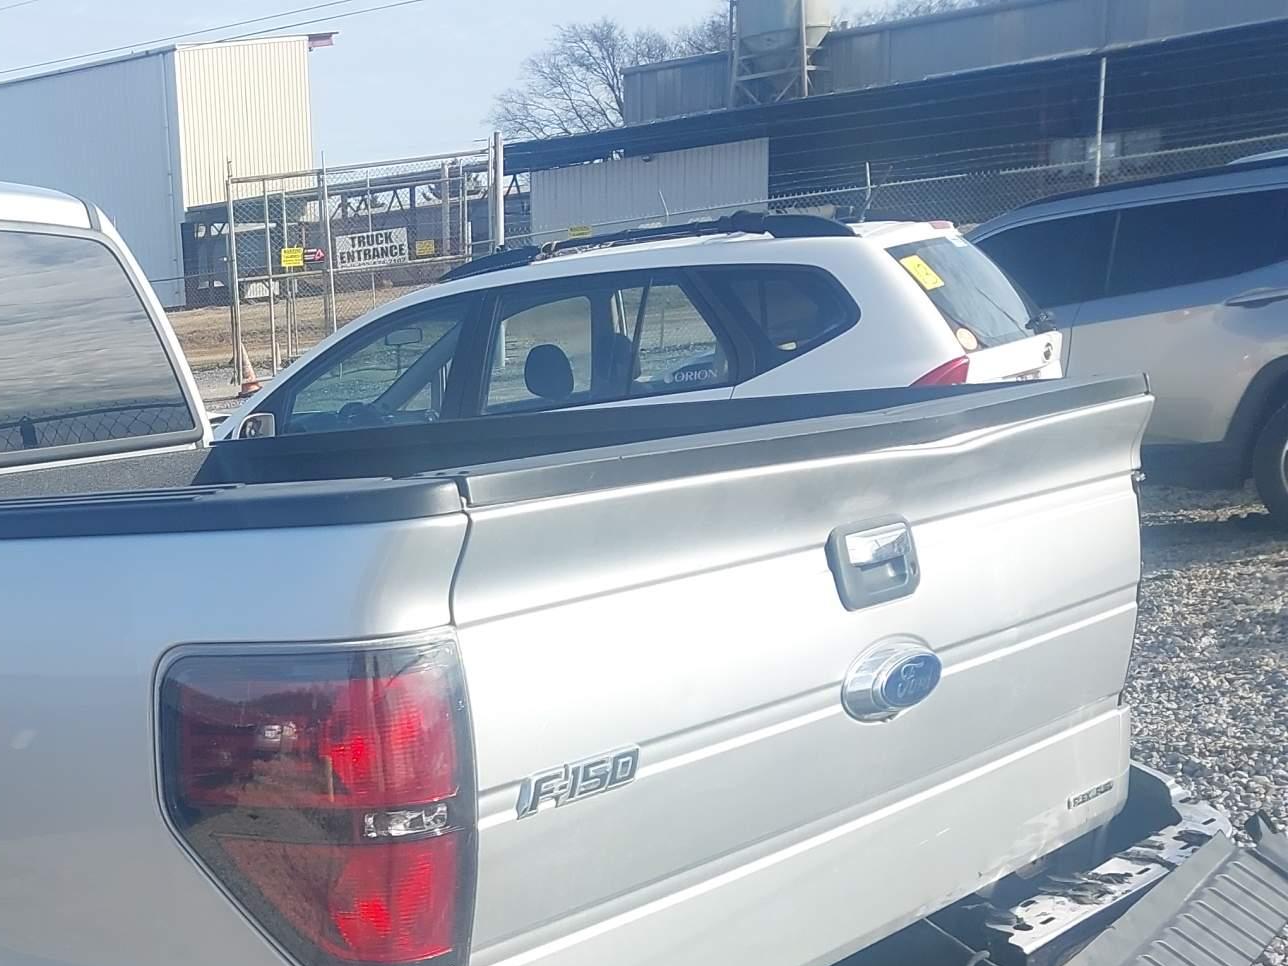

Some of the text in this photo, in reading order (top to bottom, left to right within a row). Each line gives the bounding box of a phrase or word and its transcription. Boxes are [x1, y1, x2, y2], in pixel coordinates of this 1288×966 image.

[349, 231, 394, 249] TRUCK
[339, 243, 406, 264] ENTRANCE
[674, 369, 718, 384] ORION
[897, 660, 936, 698] Ford
[516, 746, 640, 820] F-150
